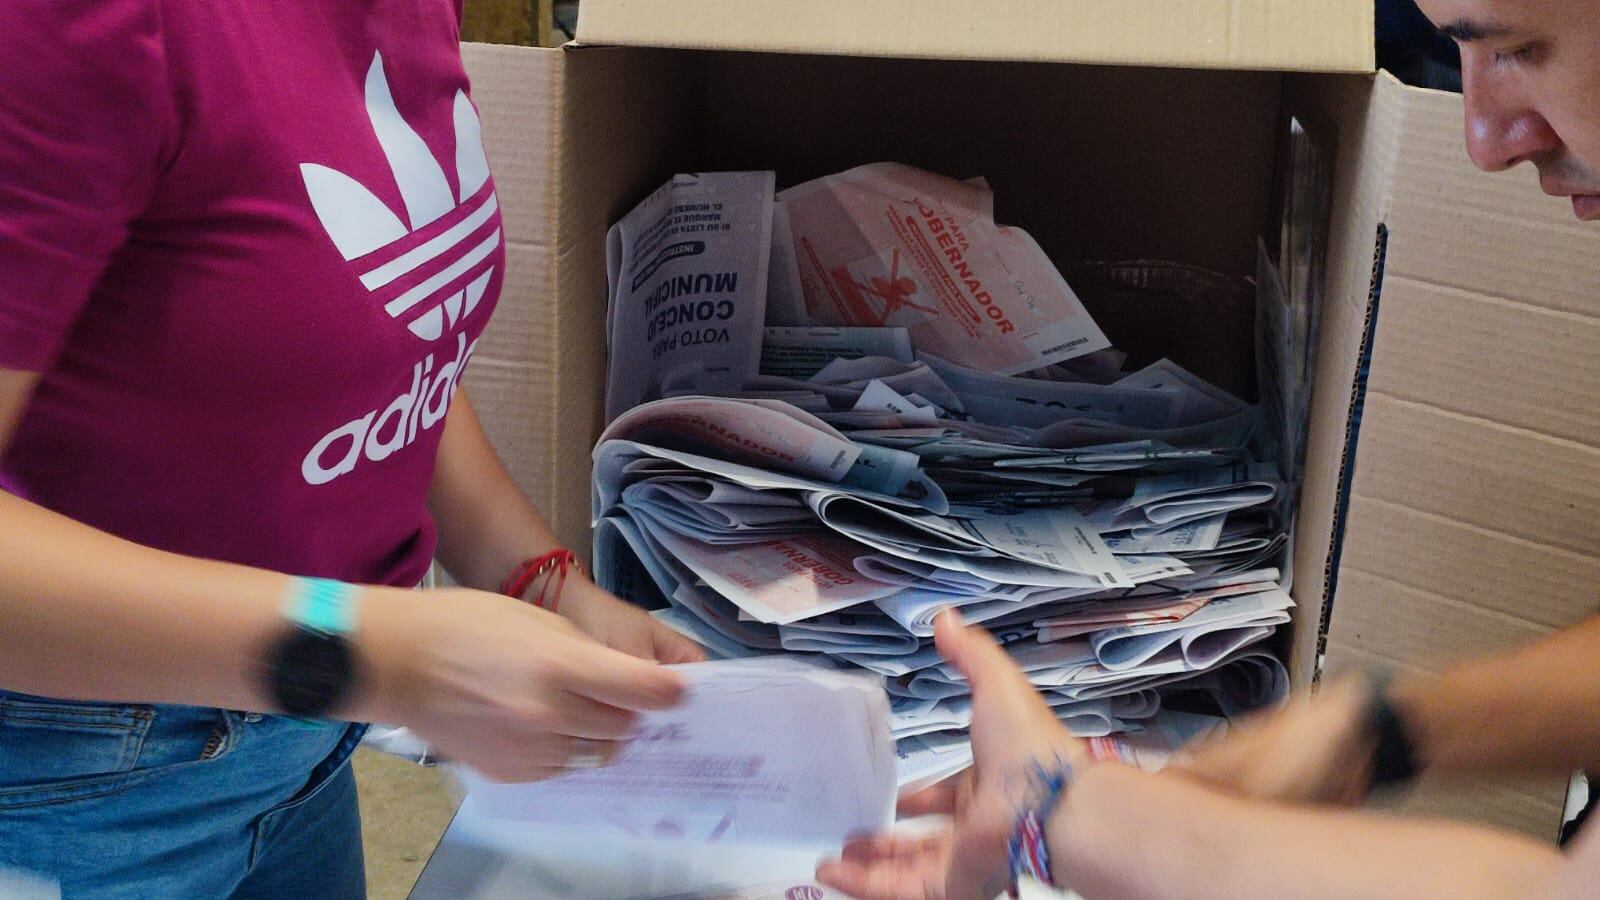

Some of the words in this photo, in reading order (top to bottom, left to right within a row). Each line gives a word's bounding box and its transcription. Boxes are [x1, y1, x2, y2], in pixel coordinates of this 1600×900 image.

[944, 216, 971, 252] PARA
[914, 197, 1016, 336] OBERNADOR
[642, 271, 738, 321] MUNICIPAL
[647, 299, 736, 343] CONCEJO
[680, 327, 730, 345] VOTO
